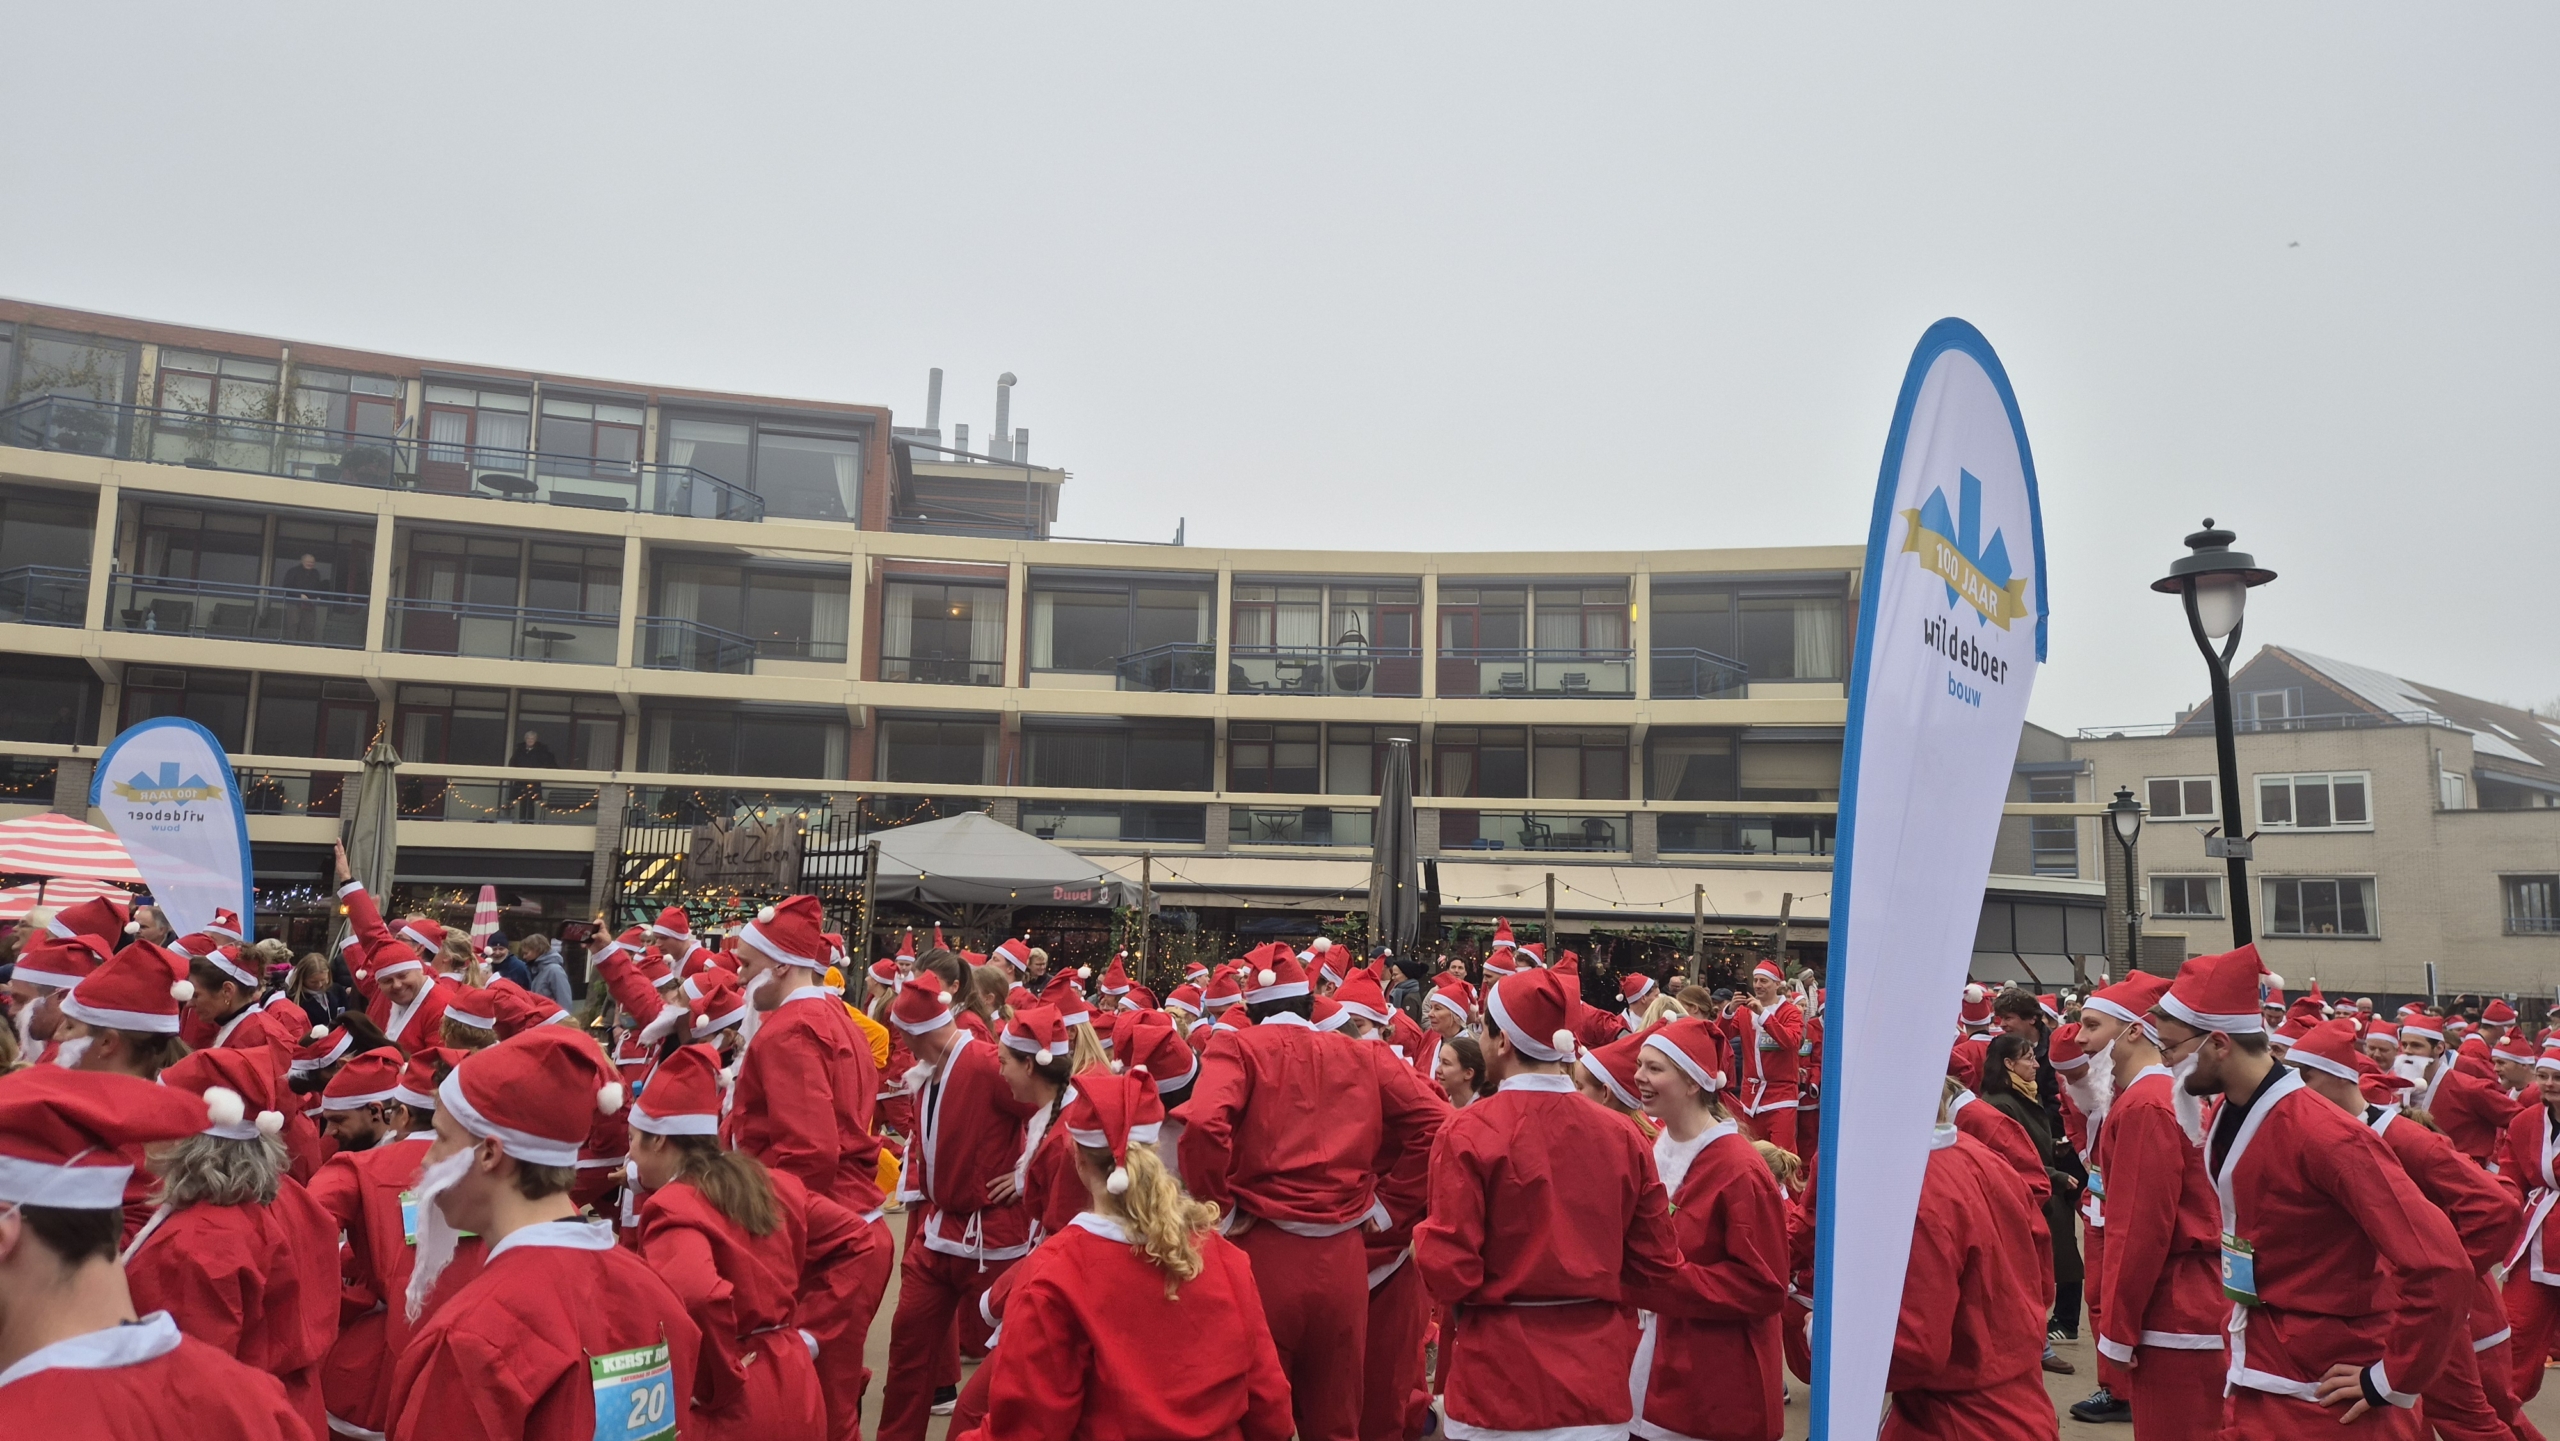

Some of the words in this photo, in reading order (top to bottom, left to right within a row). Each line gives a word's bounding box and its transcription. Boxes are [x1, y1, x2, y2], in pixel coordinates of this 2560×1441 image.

[1936, 543, 1959, 581] 100
[1961, 568, 1998, 617] JAAR
[1924, 615, 2008, 685] wildeboer
[1948, 671, 1981, 708] bouw
[742, 835, 789, 863] Zoen
[1053, 886, 1092, 901] Duvel
[602, 1350, 653, 1373] KERST
[627, 1382, 666, 1430] 20
